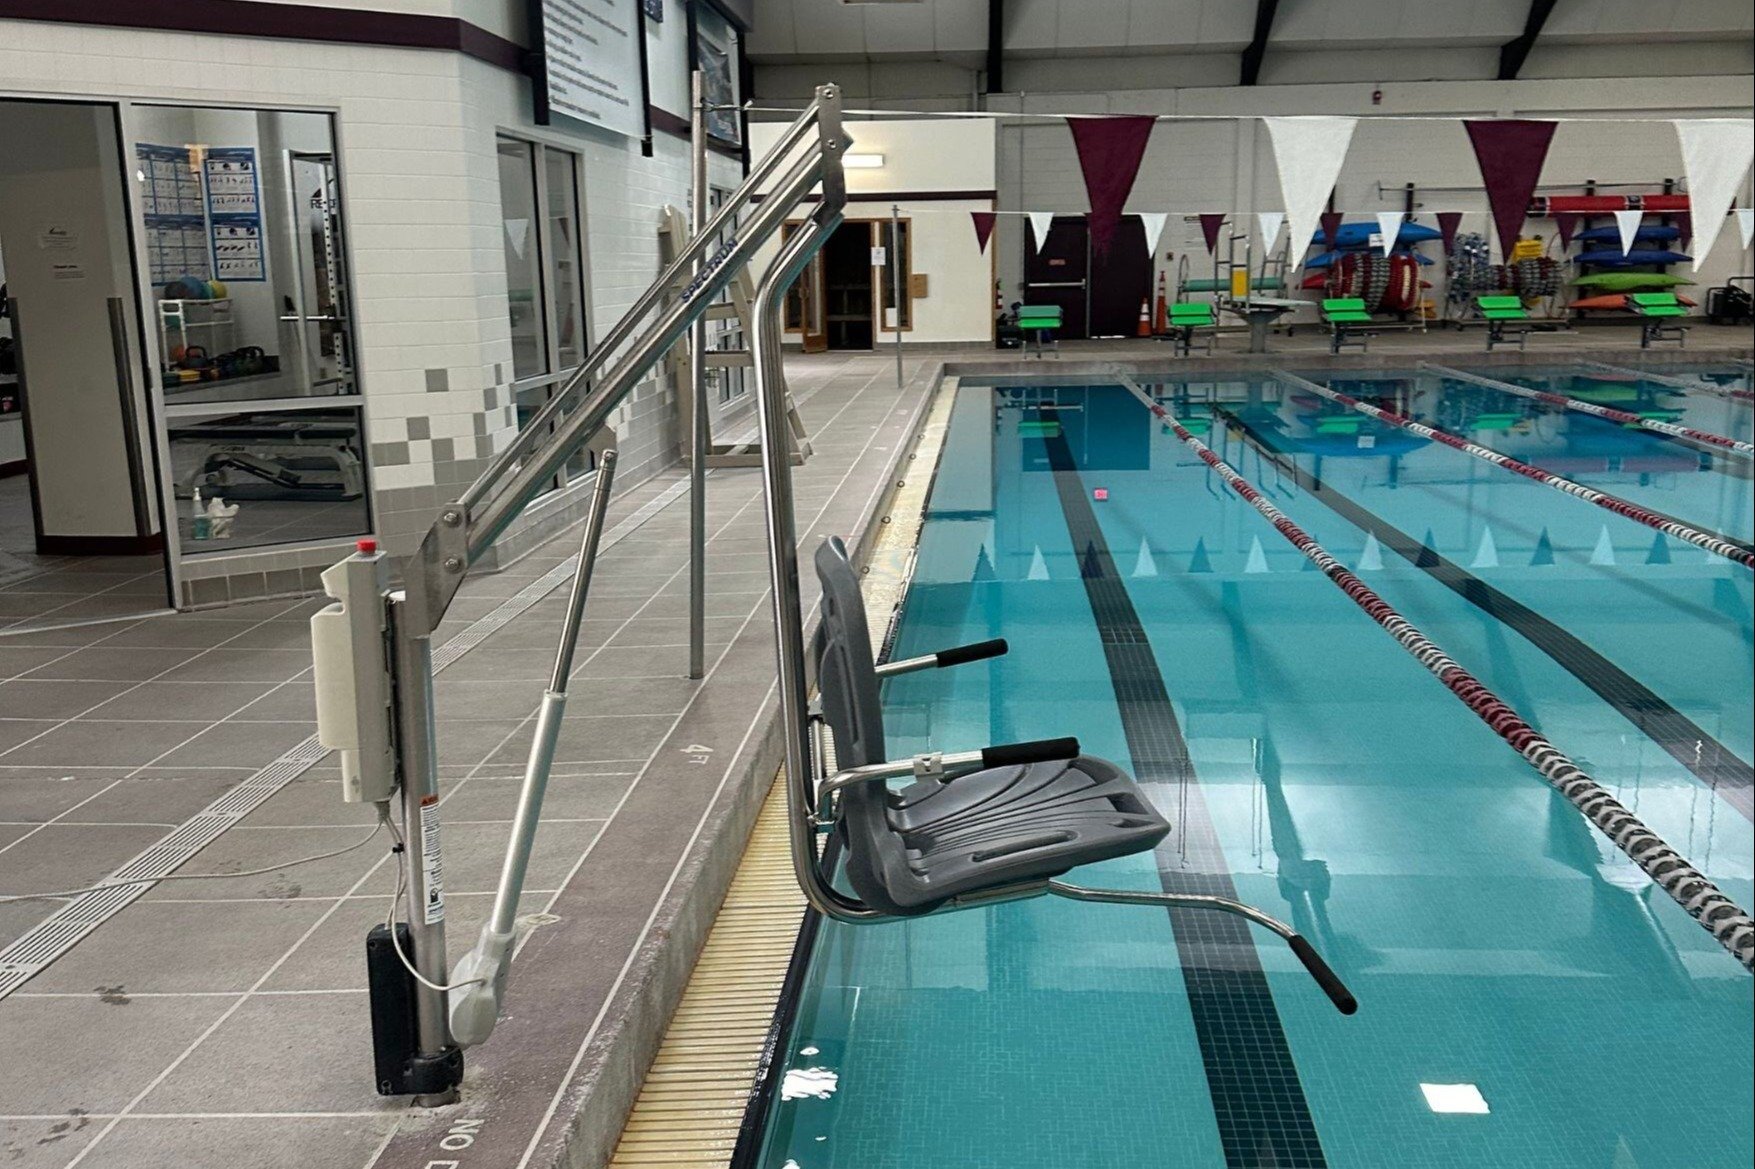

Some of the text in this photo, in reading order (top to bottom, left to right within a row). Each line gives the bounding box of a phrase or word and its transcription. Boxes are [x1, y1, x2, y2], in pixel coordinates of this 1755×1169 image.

[681, 239, 738, 303] SPECTRUM
[680, 744, 714, 764] 4 FT
[440, 1119, 485, 1151] NO
